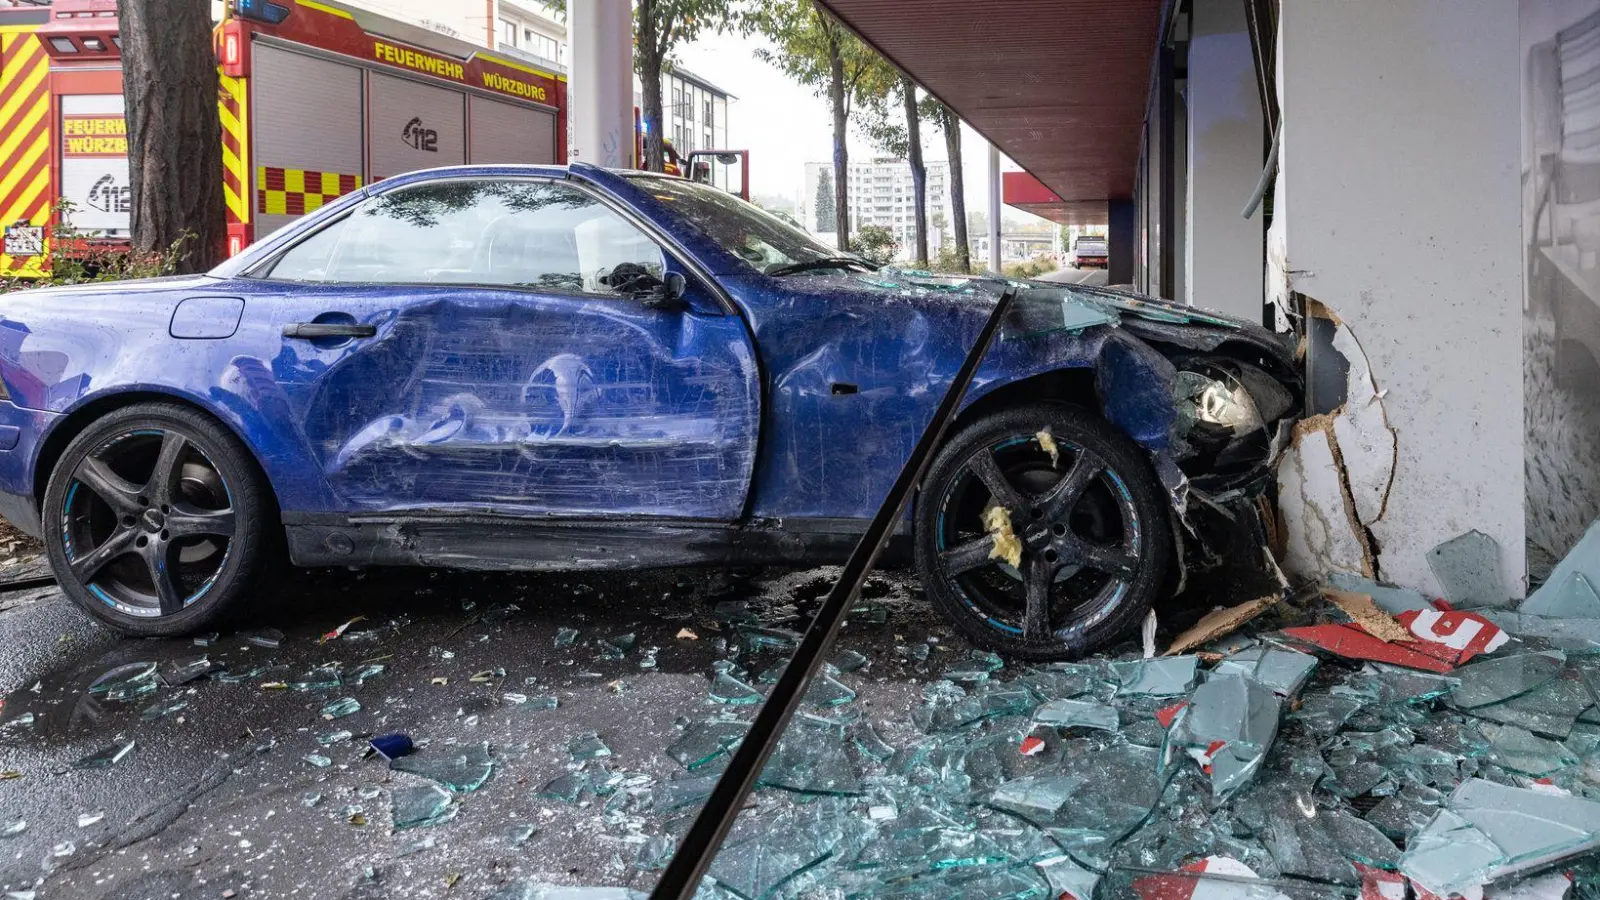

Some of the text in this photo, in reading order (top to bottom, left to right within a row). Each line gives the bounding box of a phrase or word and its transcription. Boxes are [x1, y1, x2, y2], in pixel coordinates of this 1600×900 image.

[375, 42, 546, 101] FEUERWEHR WÜRZBURG
[64, 119, 126, 135] FEUERW
[69, 137, 128, 153] WÜRZB
[412, 128, 438, 152] 112
[102, 186, 130, 212] 112
